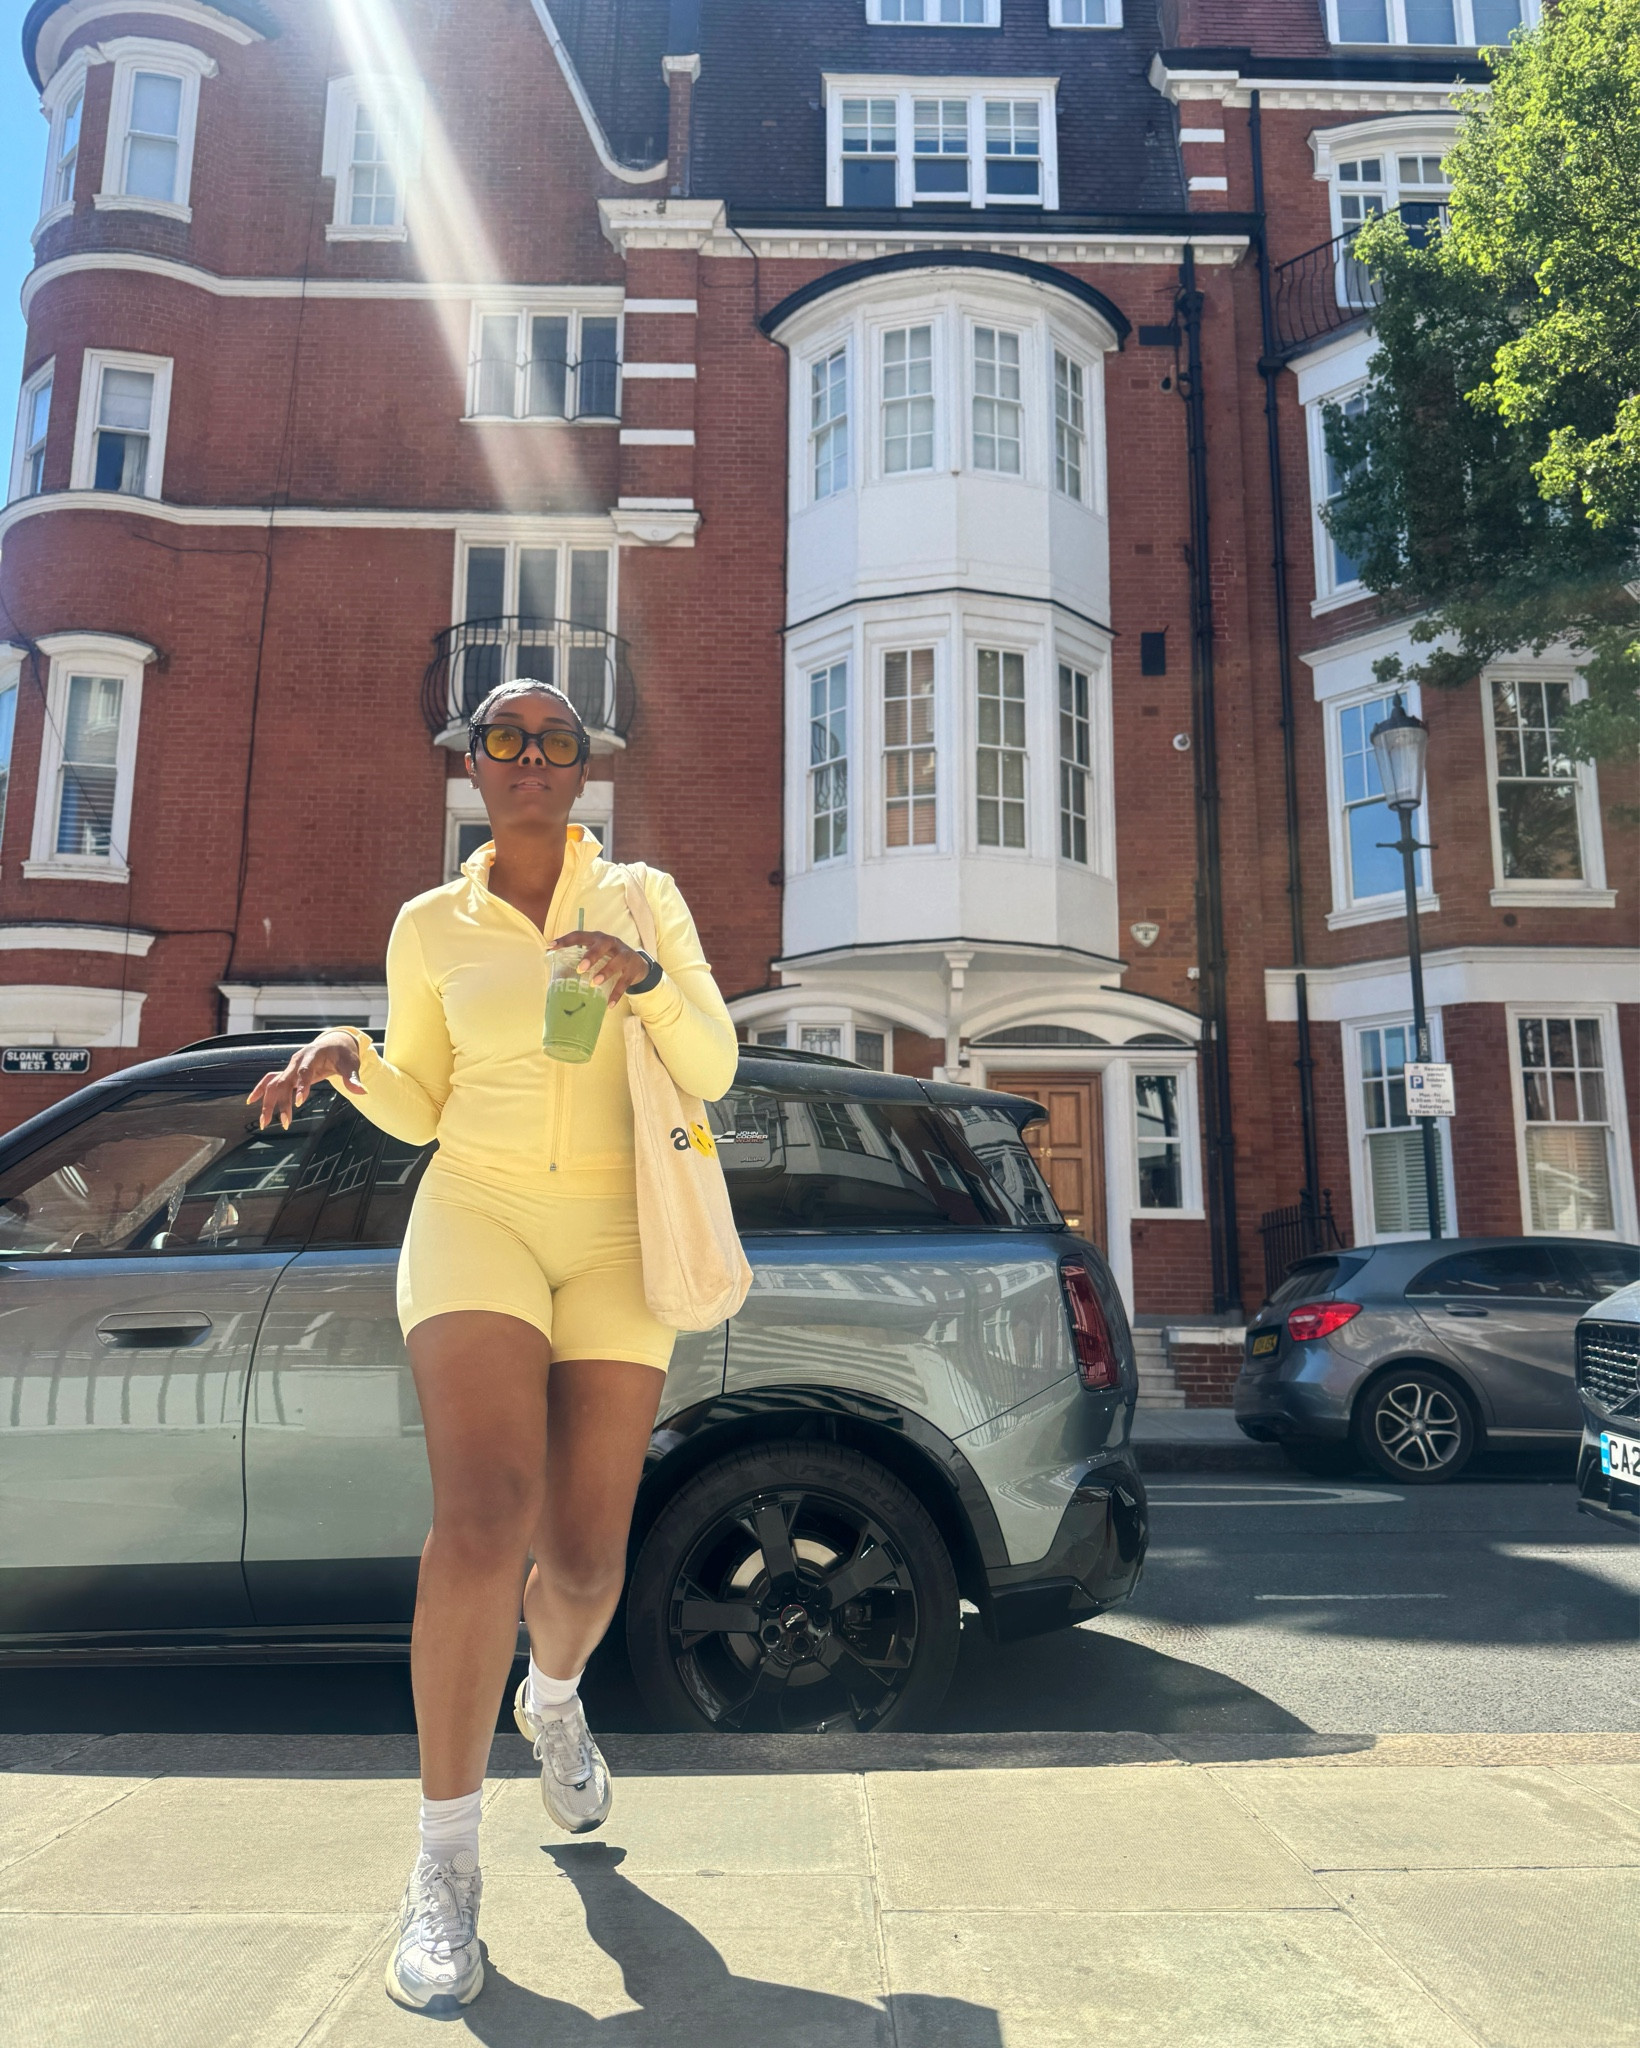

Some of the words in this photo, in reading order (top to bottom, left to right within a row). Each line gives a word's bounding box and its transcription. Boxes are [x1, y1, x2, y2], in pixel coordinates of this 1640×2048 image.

[7, 1052, 45, 1061] SLOANE
[52, 1052, 86, 1061] COURT
[20, 1061, 48, 1070] WEST
[1412, 1076, 1422, 1088] P
[1608, 1440, 1640, 1477] CA2
